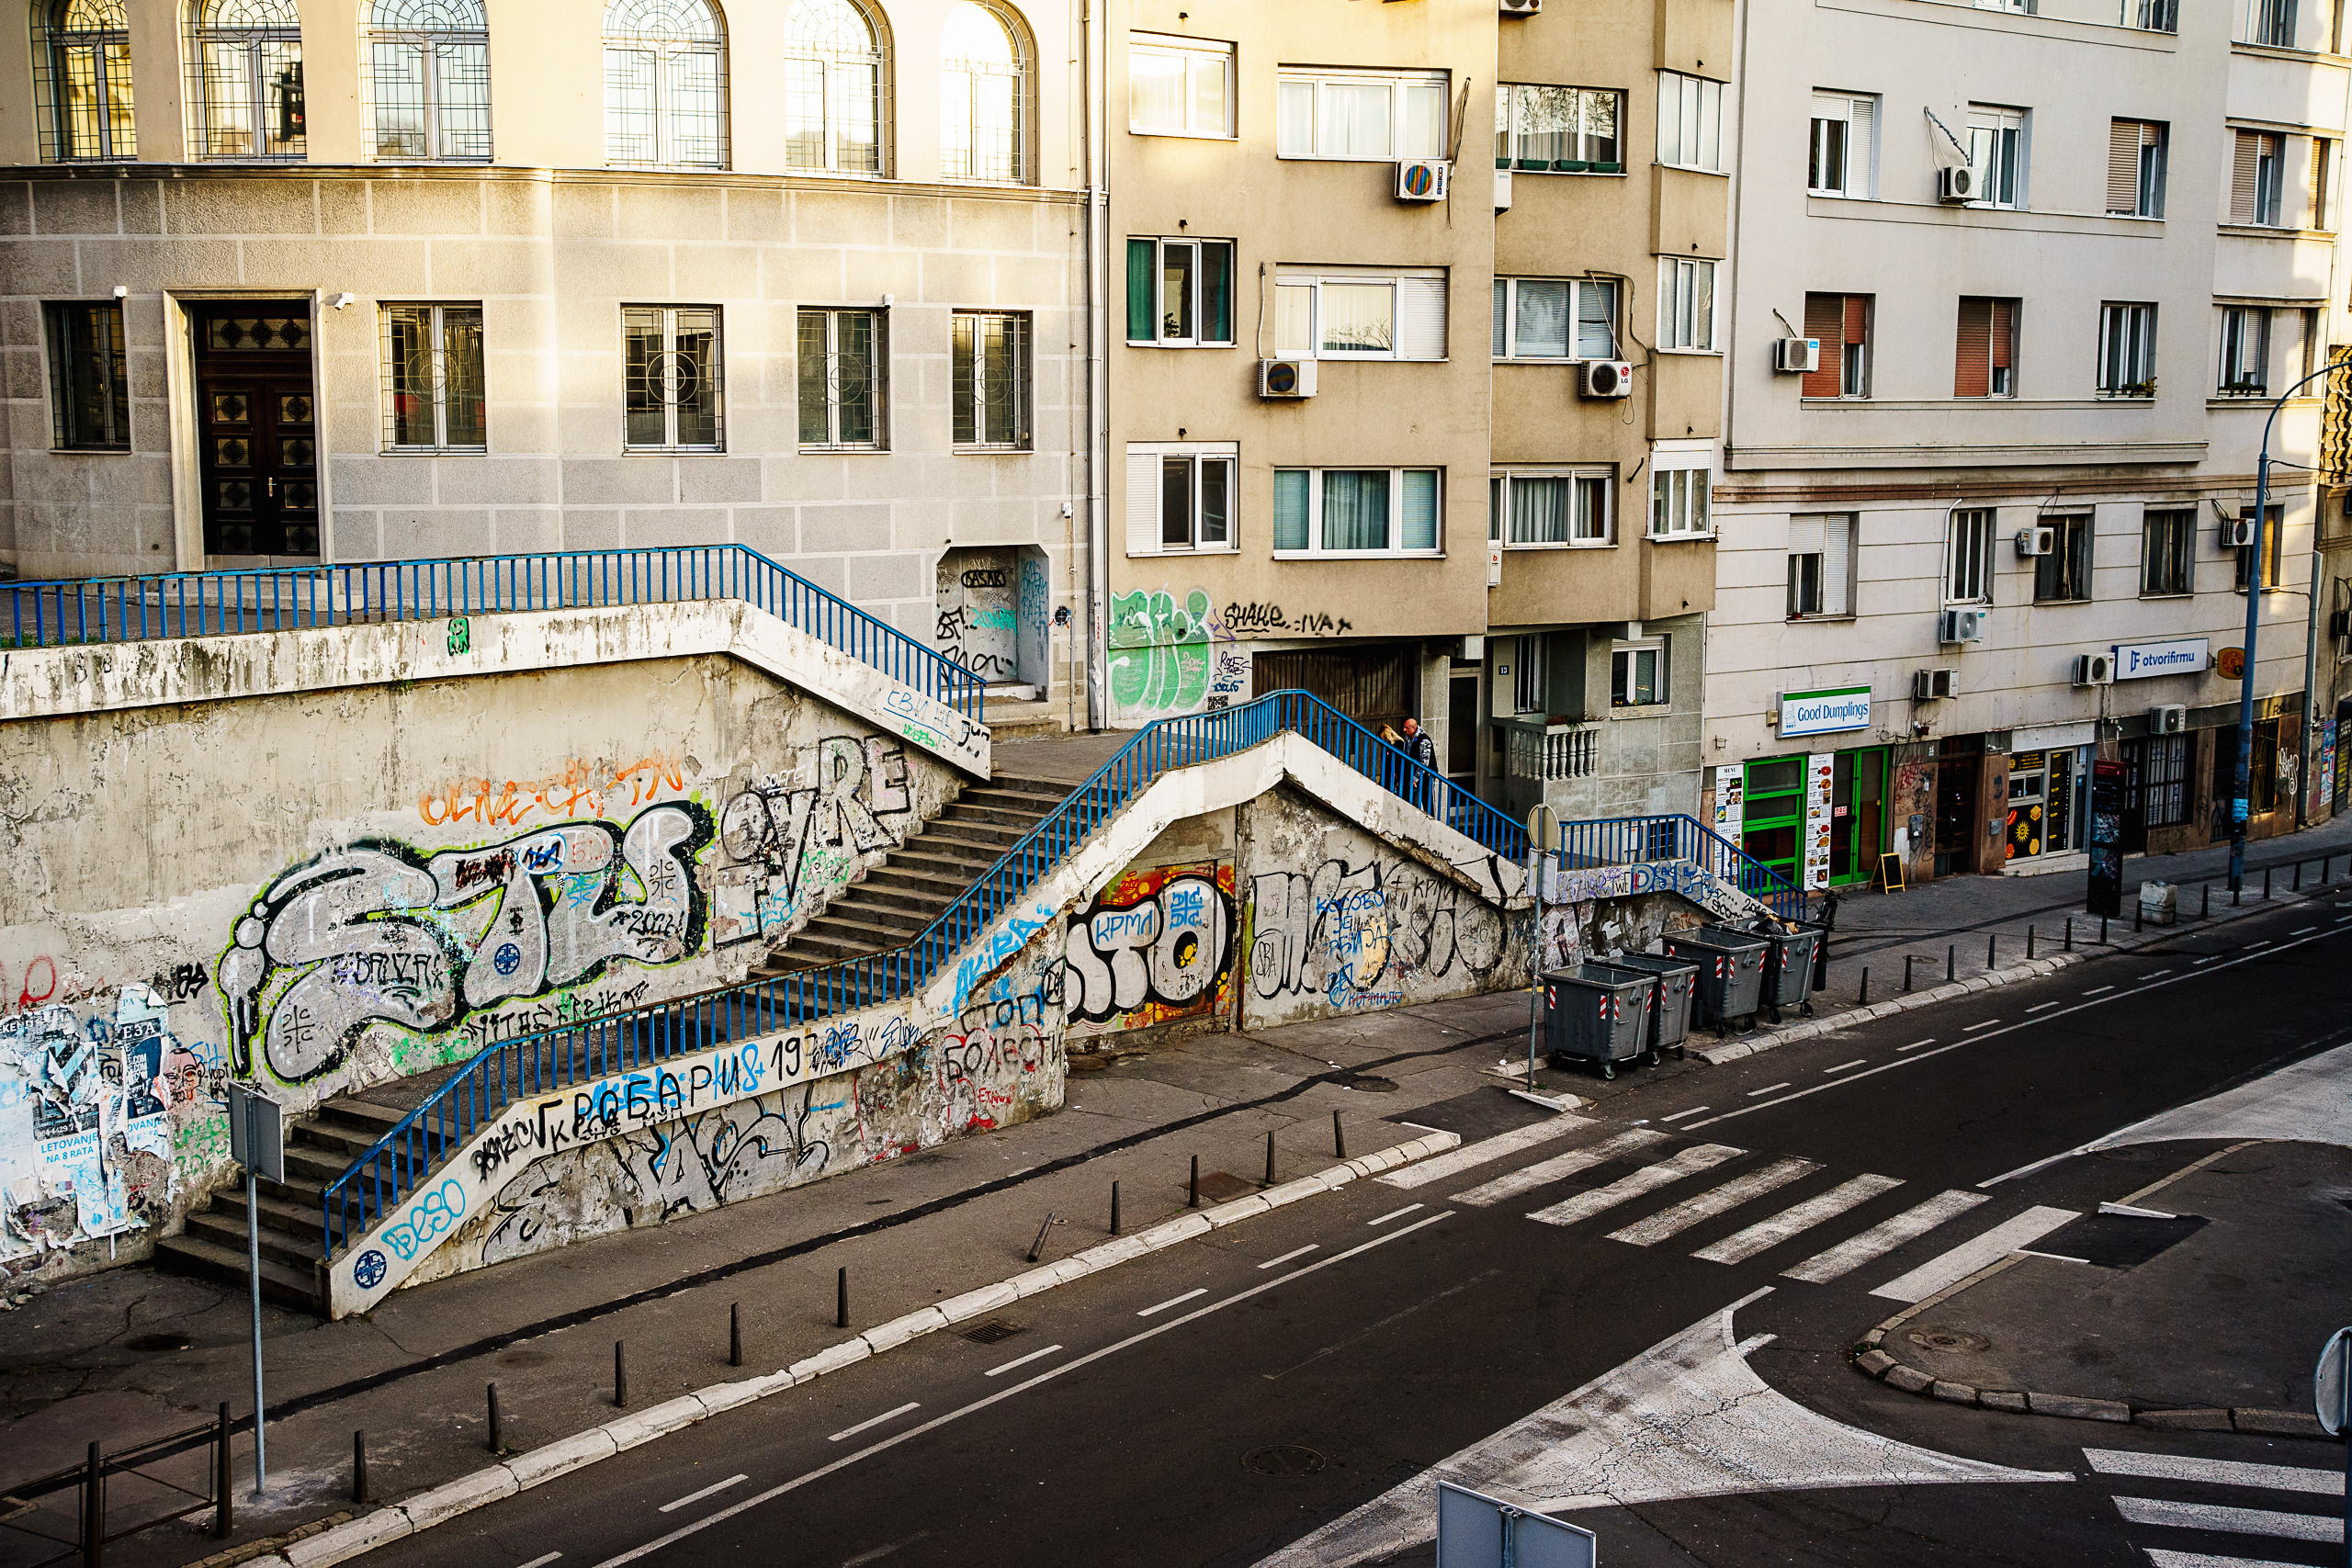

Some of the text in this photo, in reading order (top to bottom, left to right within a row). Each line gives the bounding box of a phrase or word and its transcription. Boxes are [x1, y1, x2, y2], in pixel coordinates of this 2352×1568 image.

[2143, 650, 2195, 667] otvorifirmu
[1500, 666, 1508, 674] 13
[1797, 700, 1869, 722] Good Dumplings
[40, 1132, 98, 1154] LETOVANJE
[46, 1145, 95, 1164] NA 8 RATA
